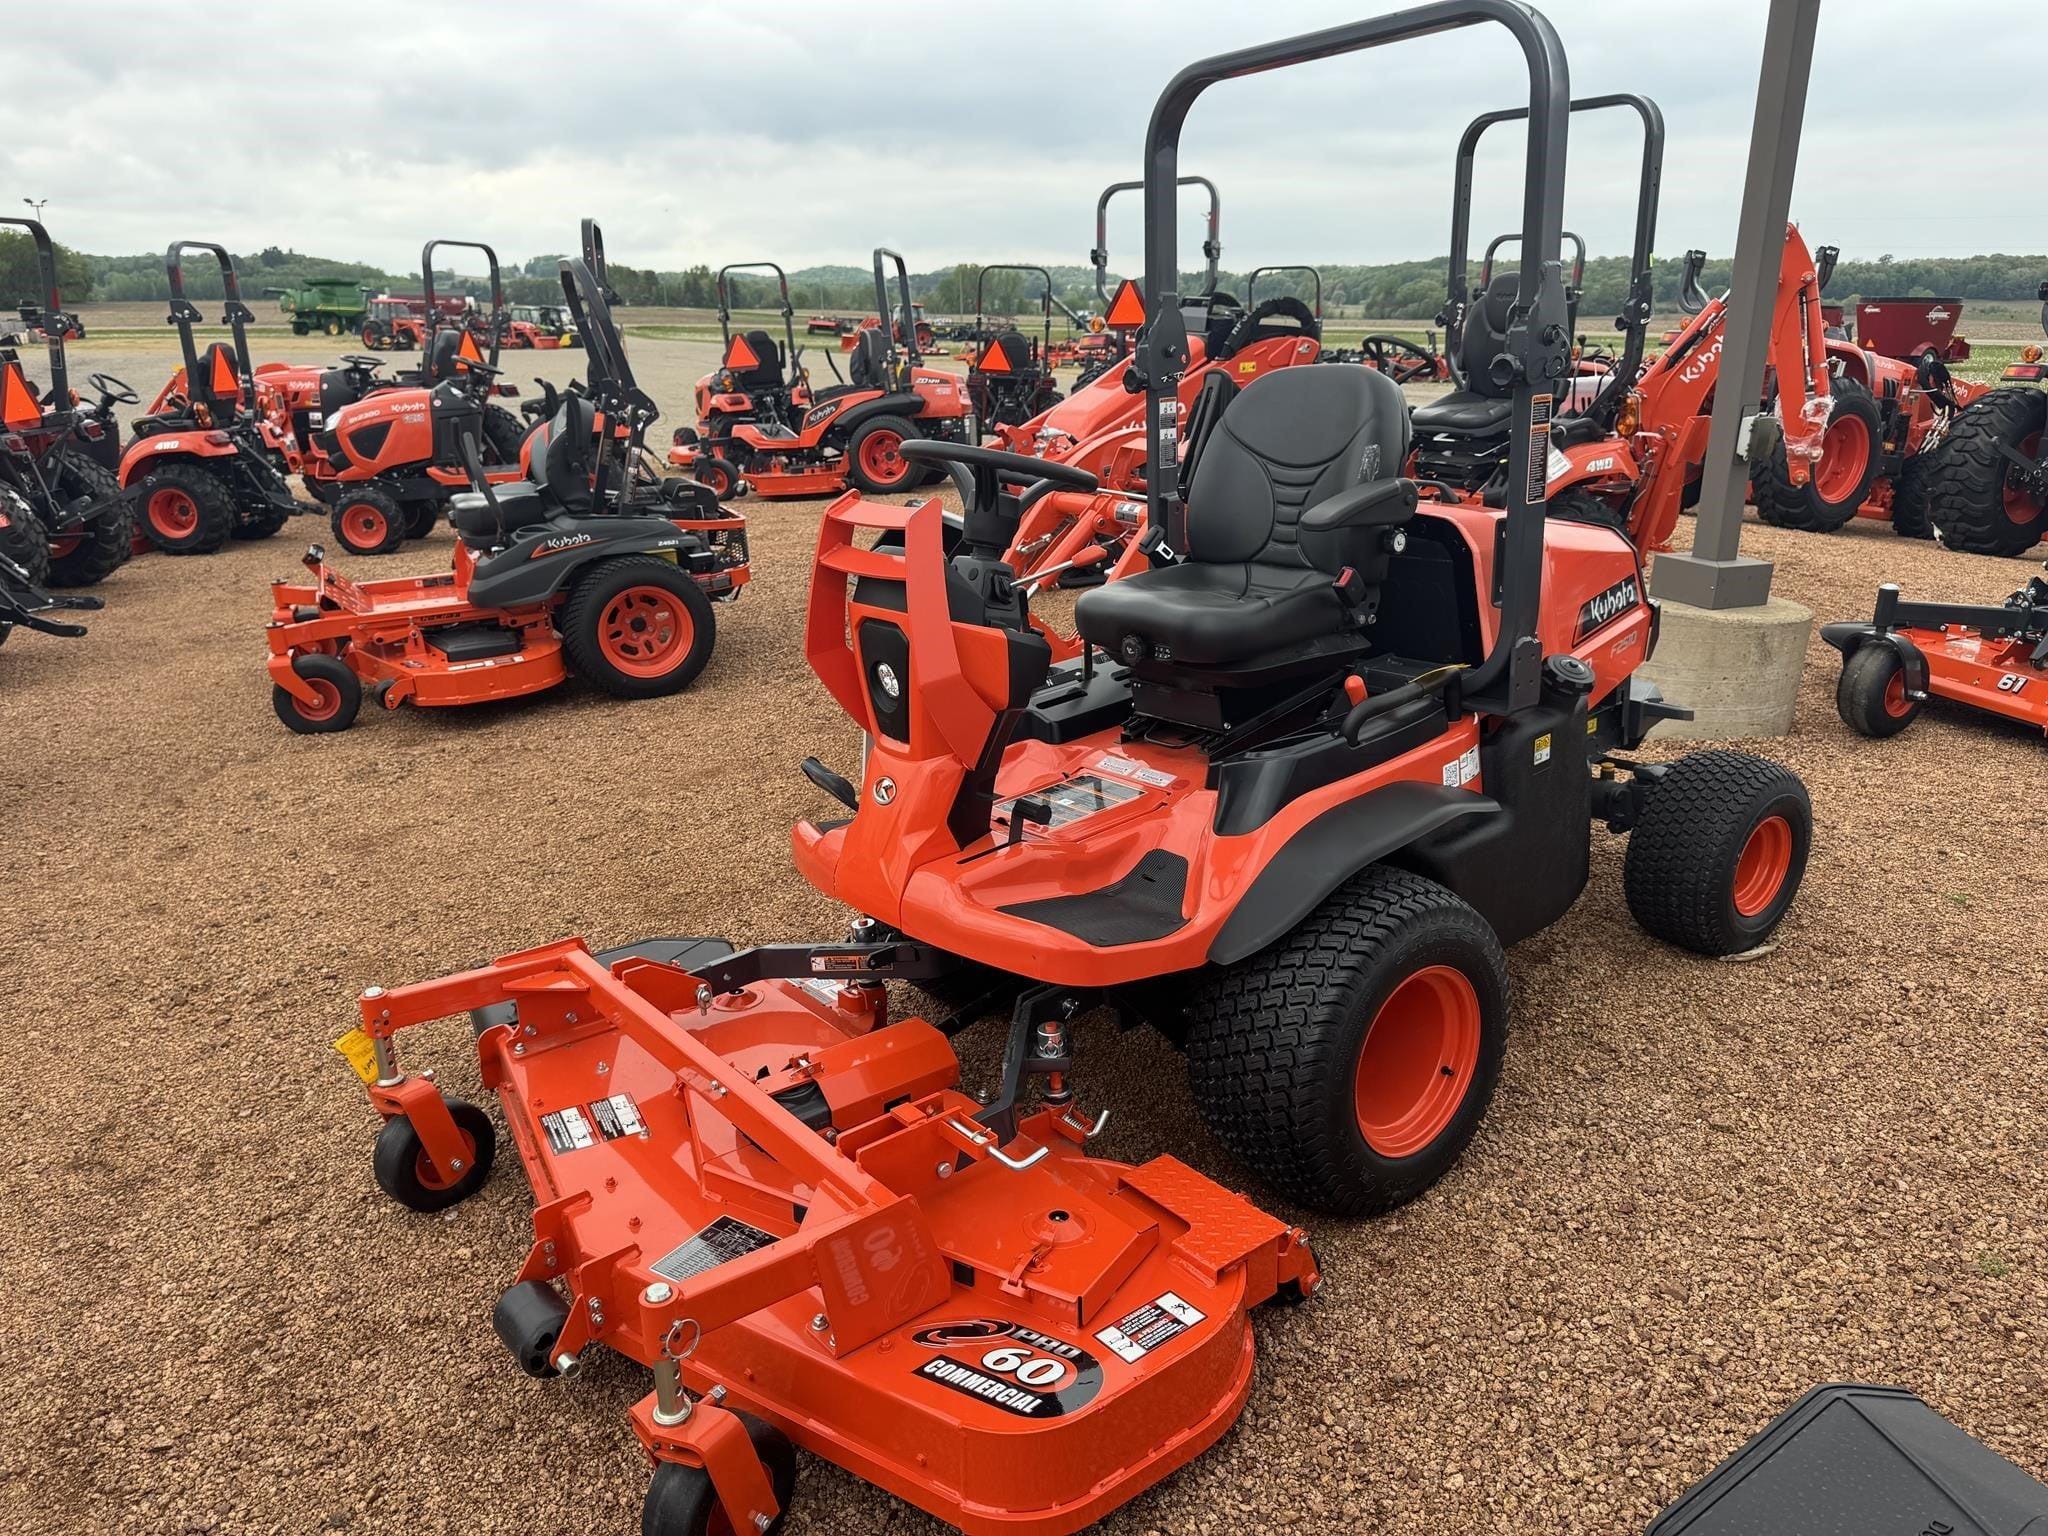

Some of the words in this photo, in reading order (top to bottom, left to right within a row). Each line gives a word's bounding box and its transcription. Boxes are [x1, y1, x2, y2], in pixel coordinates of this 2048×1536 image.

[1680, 335, 1724, 384] Kubot
[289, 381, 316, 390] Kubota
[391, 403, 426, 413] Kubota
[809, 404, 837, 422] Kubota
[154, 440, 180, 450] 4WD
[1585, 457, 1614, 473] 4WD
[547, 533, 591, 549] Kubota
[1590, 581, 1635, 623] Kubota
[1997, 673, 2028, 695] 61
[1010, 1327, 1083, 1359] PRO
[981, 1347, 1067, 1387] 60
[923, 1359, 1043, 1413] COMMERCIAL
